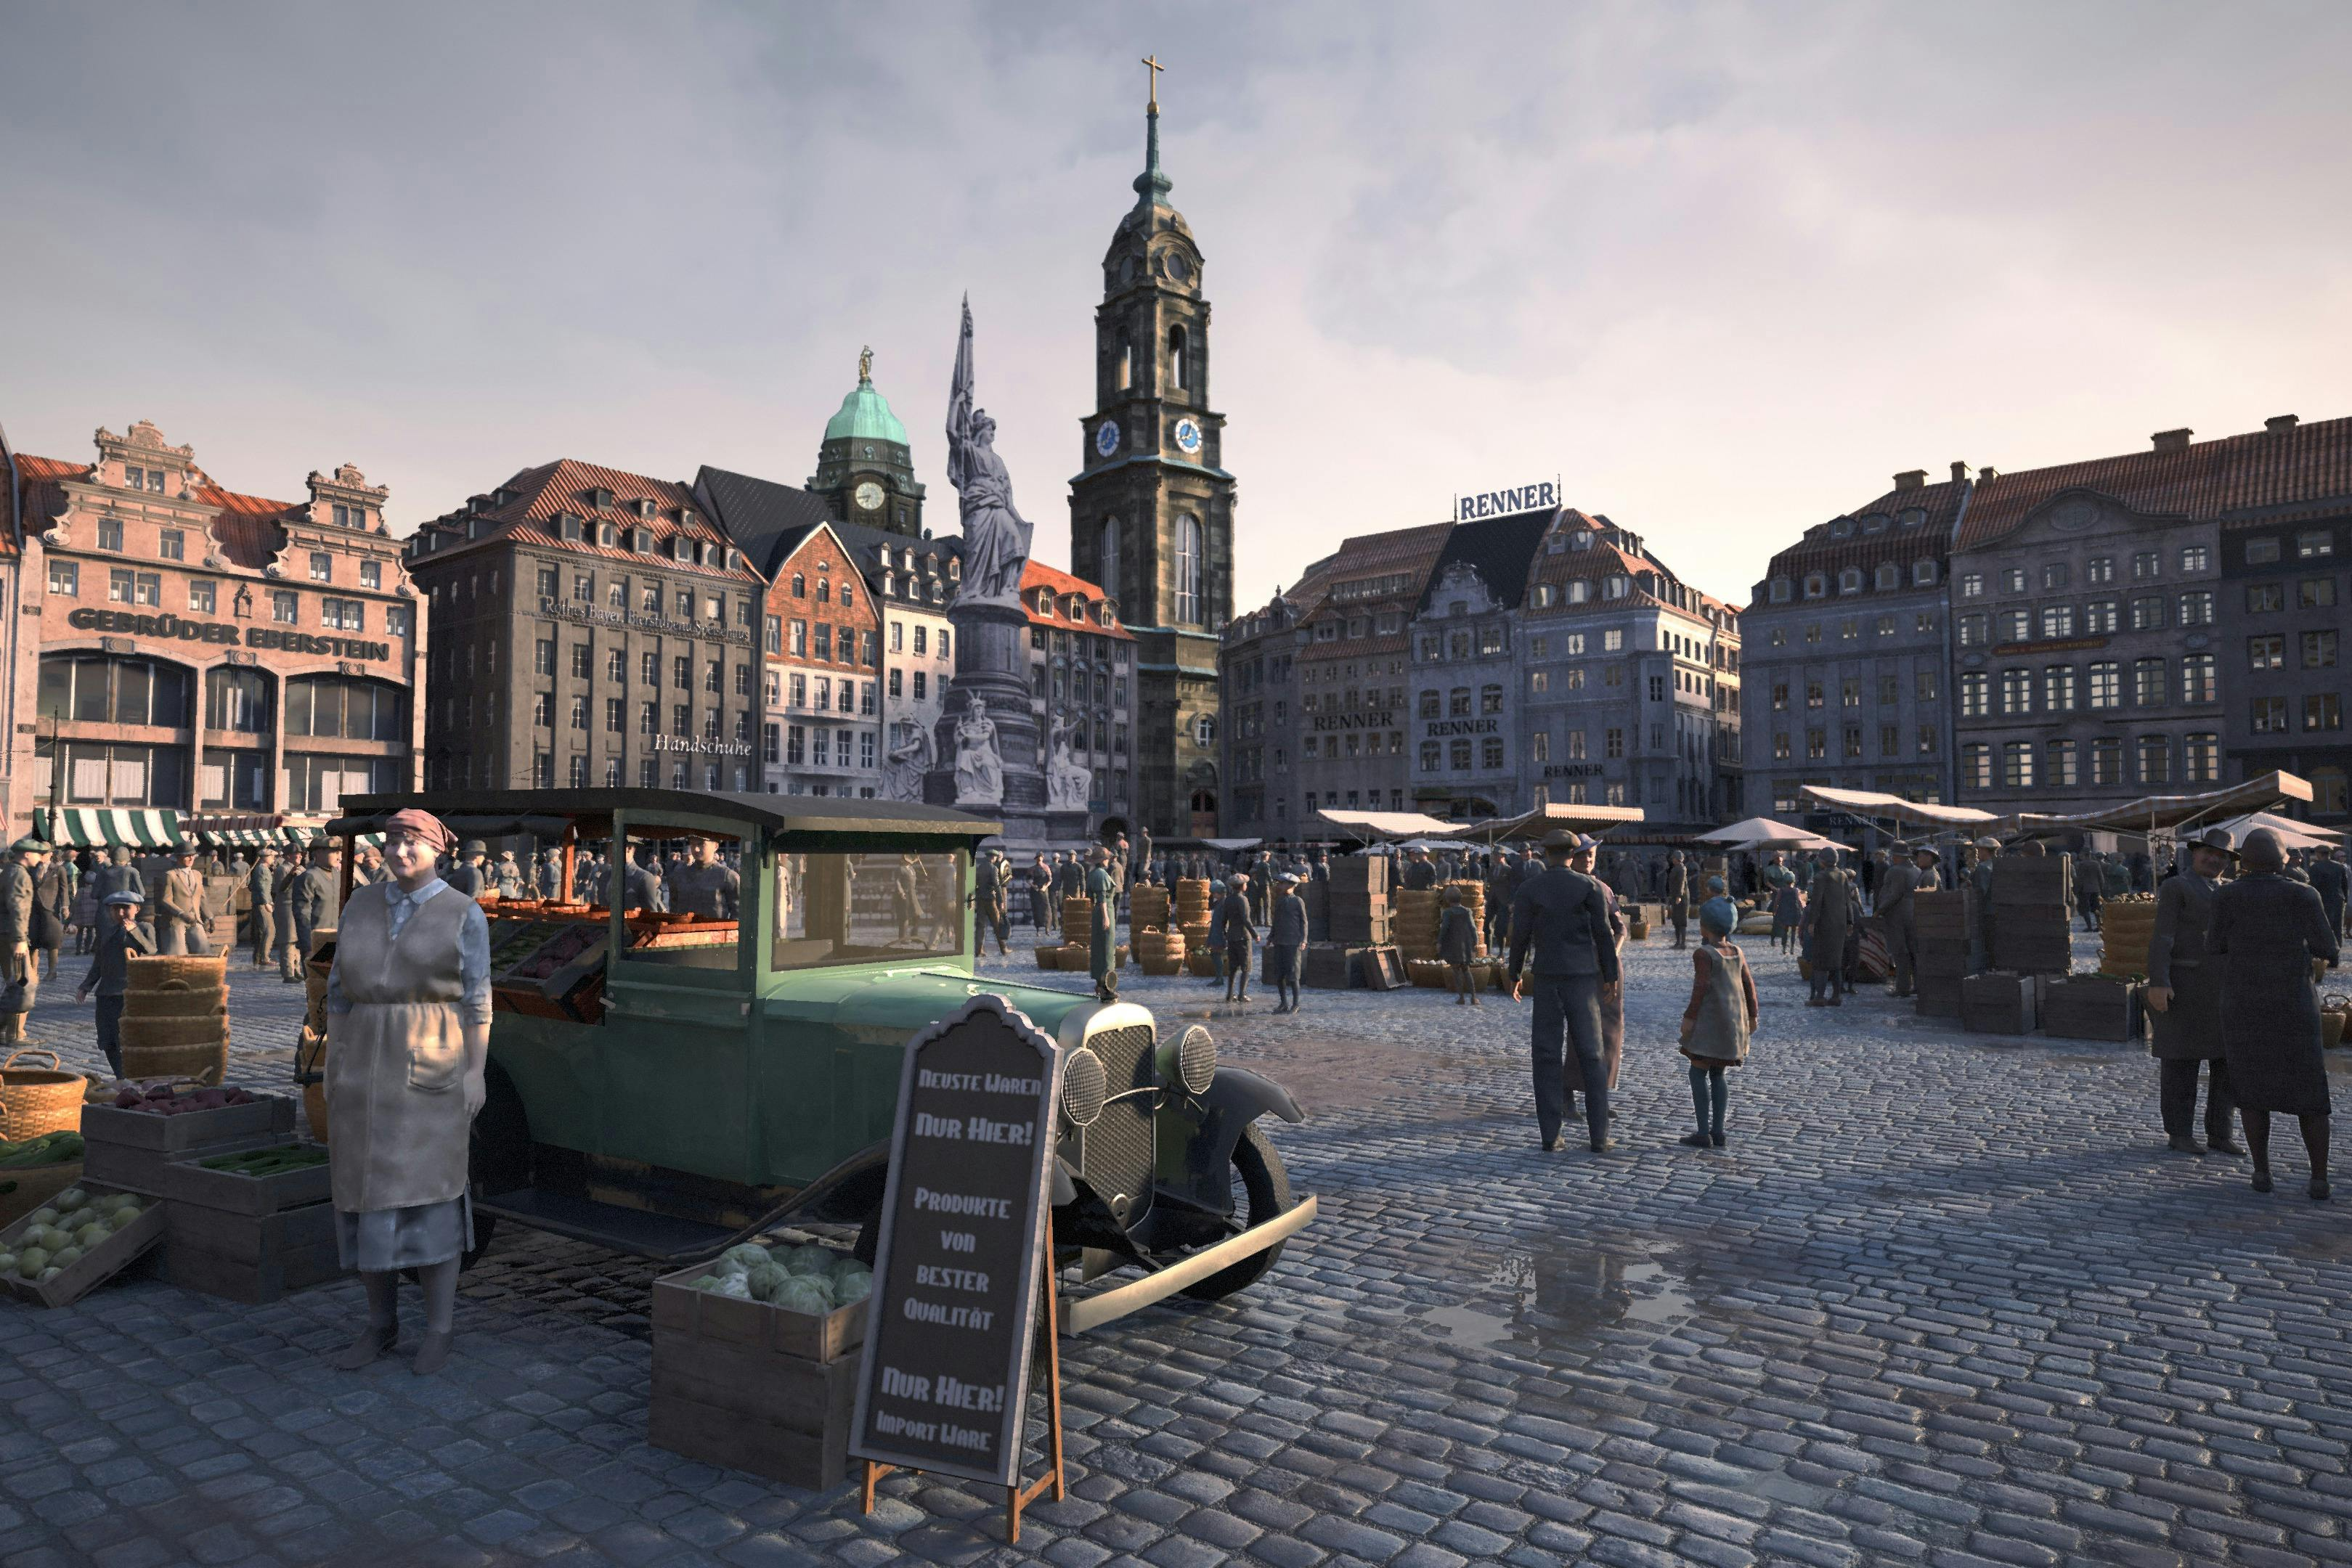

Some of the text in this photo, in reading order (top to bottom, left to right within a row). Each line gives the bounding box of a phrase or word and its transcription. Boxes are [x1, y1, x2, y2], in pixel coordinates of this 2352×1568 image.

[1460, 482, 1555, 520] RENNER
[68, 607, 390, 662] GEBRÜDER EBERSTEIN
[1314, 711, 1395, 732] RENNER
[1427, 719, 1498, 737] RENNER
[654, 734, 752, 756] Handschuhe
[1544, 763, 1604, 779] RENNER
[1829, 814, 1879, 826] RENNER
